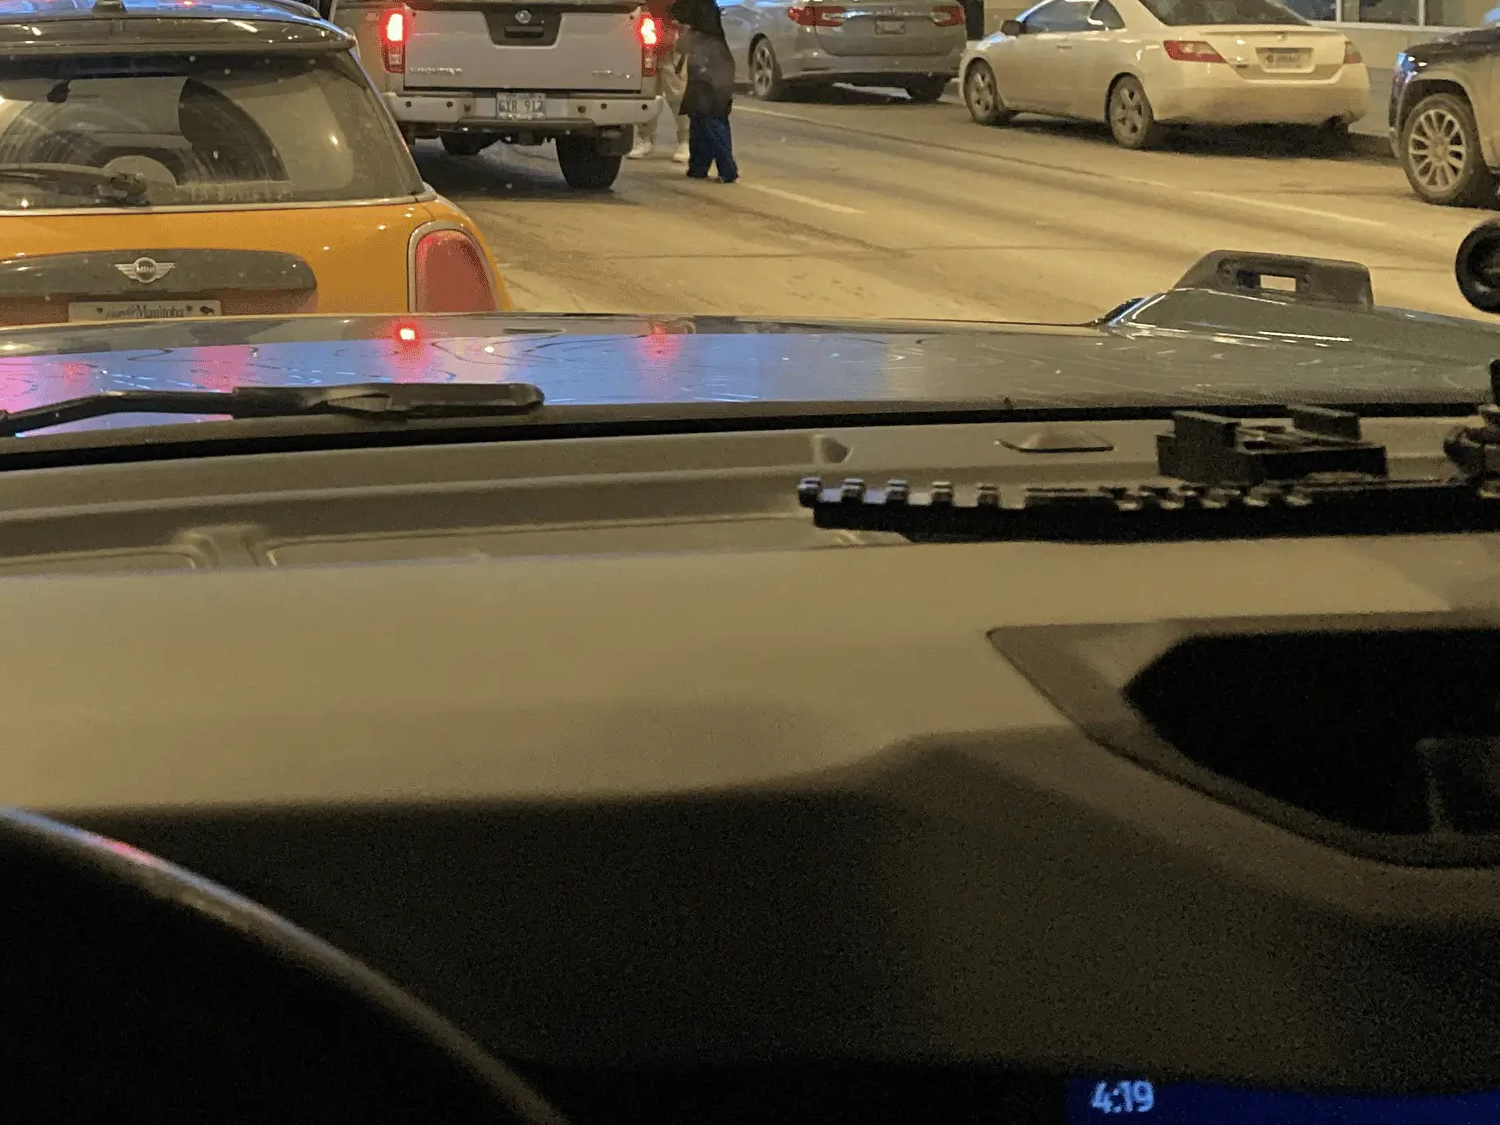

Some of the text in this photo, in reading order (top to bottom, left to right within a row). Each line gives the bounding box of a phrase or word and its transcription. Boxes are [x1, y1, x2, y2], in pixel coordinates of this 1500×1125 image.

[136, 265, 155, 274] MINI
[136, 303, 185, 319] Manitoba
[1091, 1080, 1155, 1114] 4:19
